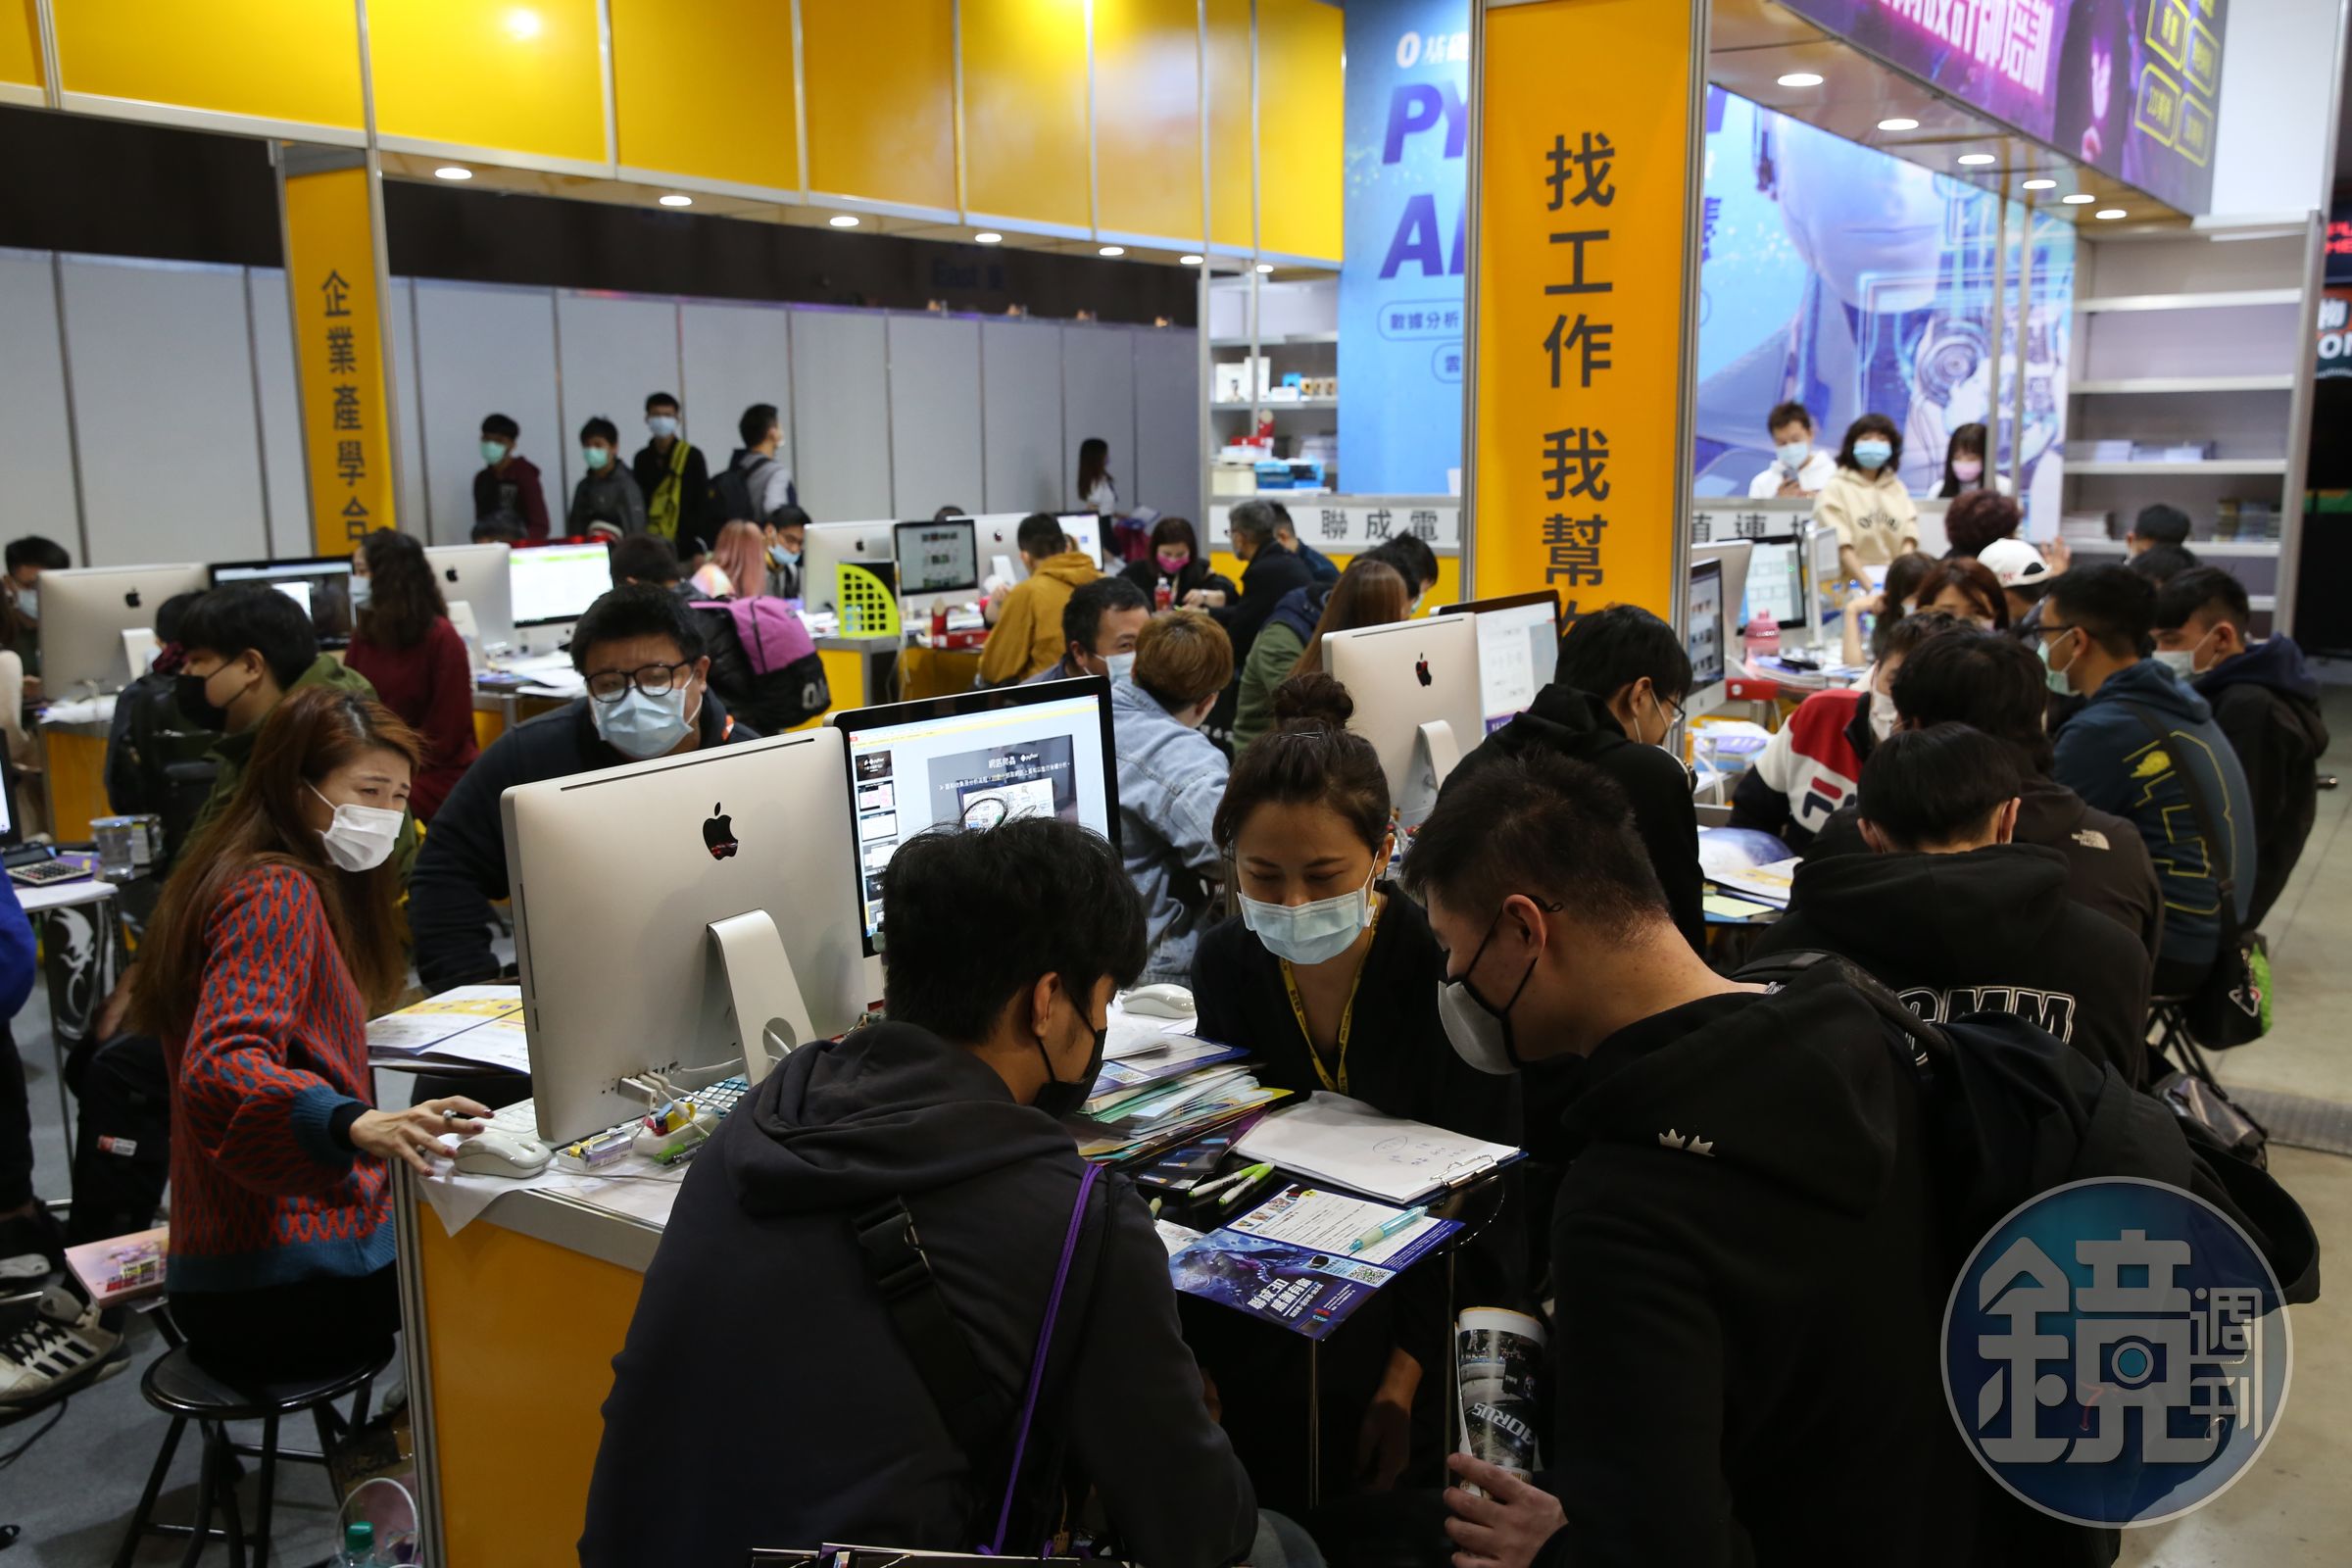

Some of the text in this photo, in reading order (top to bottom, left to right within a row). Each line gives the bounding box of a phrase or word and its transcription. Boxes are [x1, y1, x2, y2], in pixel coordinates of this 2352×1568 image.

[1544, 132, 1615, 388] 找工作
[1321, 509, 1461, 541] 聯成電
